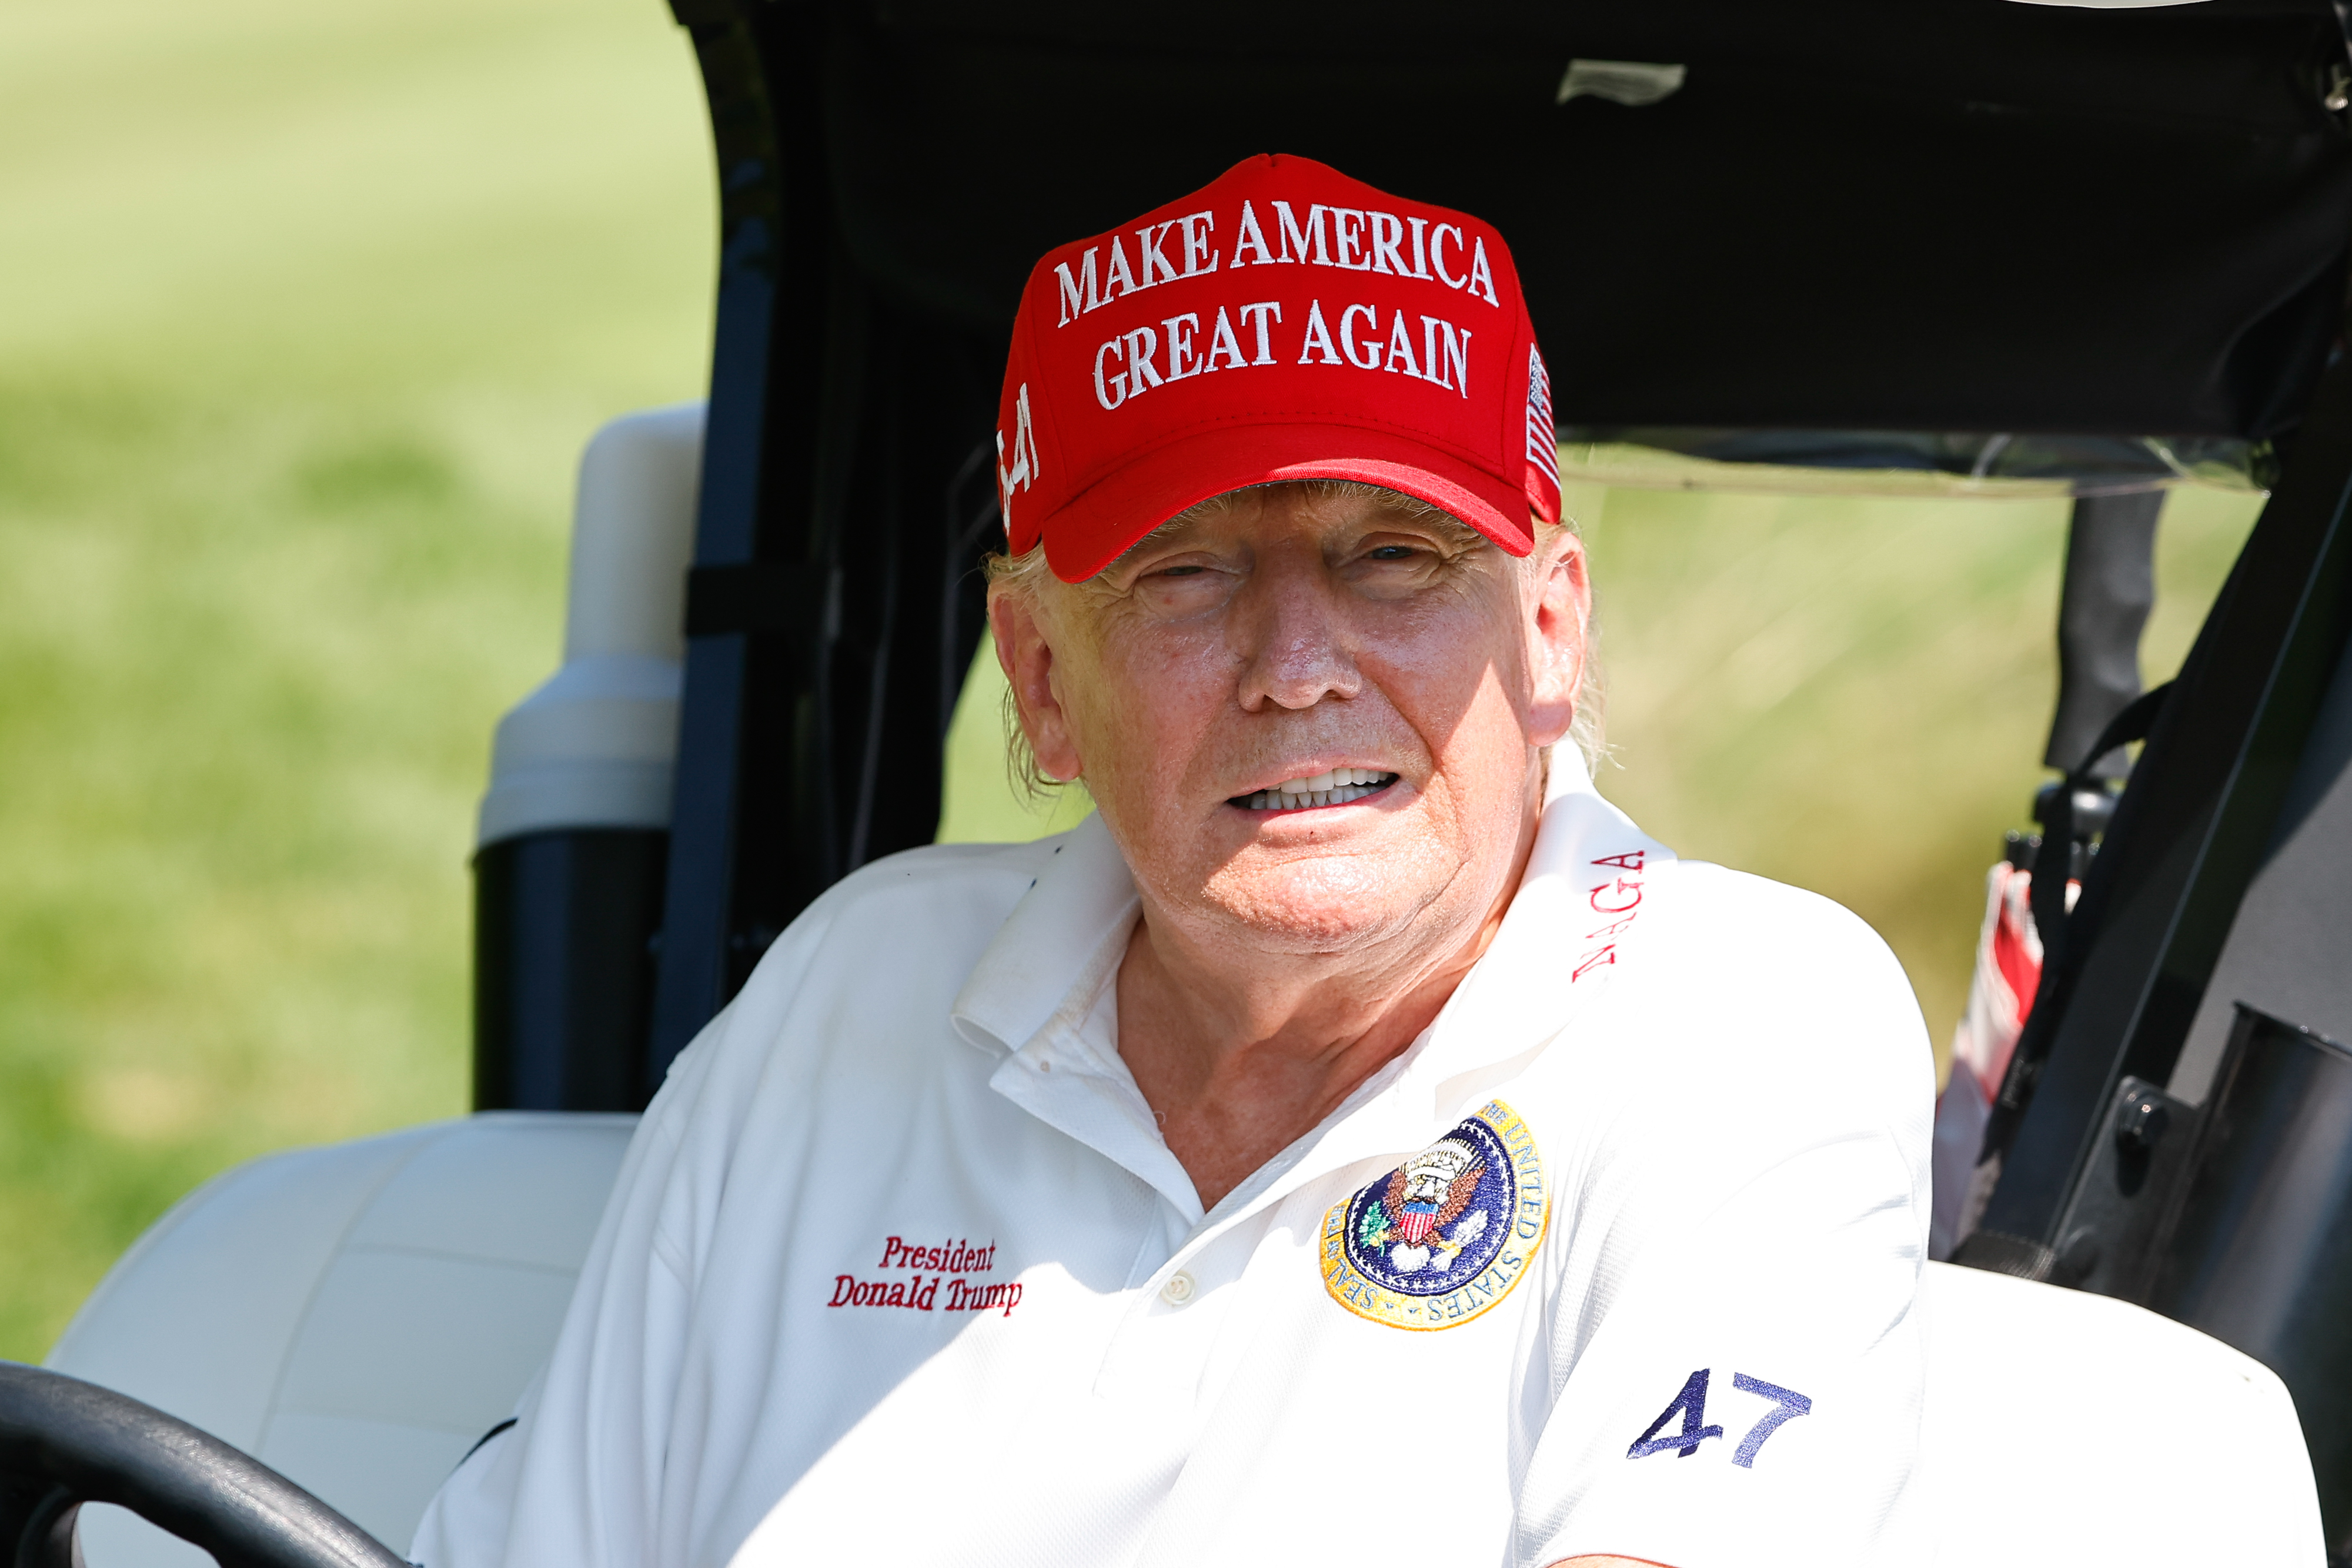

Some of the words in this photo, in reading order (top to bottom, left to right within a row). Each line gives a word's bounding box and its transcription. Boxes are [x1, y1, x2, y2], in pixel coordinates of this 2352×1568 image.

[1054, 210, 1219, 328] MAKE
[1230, 200, 1500, 308] AMERICA
[1093, 301, 1283, 411] GREAT
[1298, 299, 1472, 400] AGAIN
[1572, 850, 1645, 984] MAGA
[1505, 1122, 1543, 1239] UNITED
[878, 1236, 995, 1273] President
[1327, 1240, 1340, 1260] OF
[1328, 1258, 1379, 1309] SEAL
[1428, 1250, 1522, 1321] STATES
[827, 1275, 940, 1311] Donald
[944, 1279, 1023, 1318] Trump
[1625, 1367, 1812, 1469] 47
